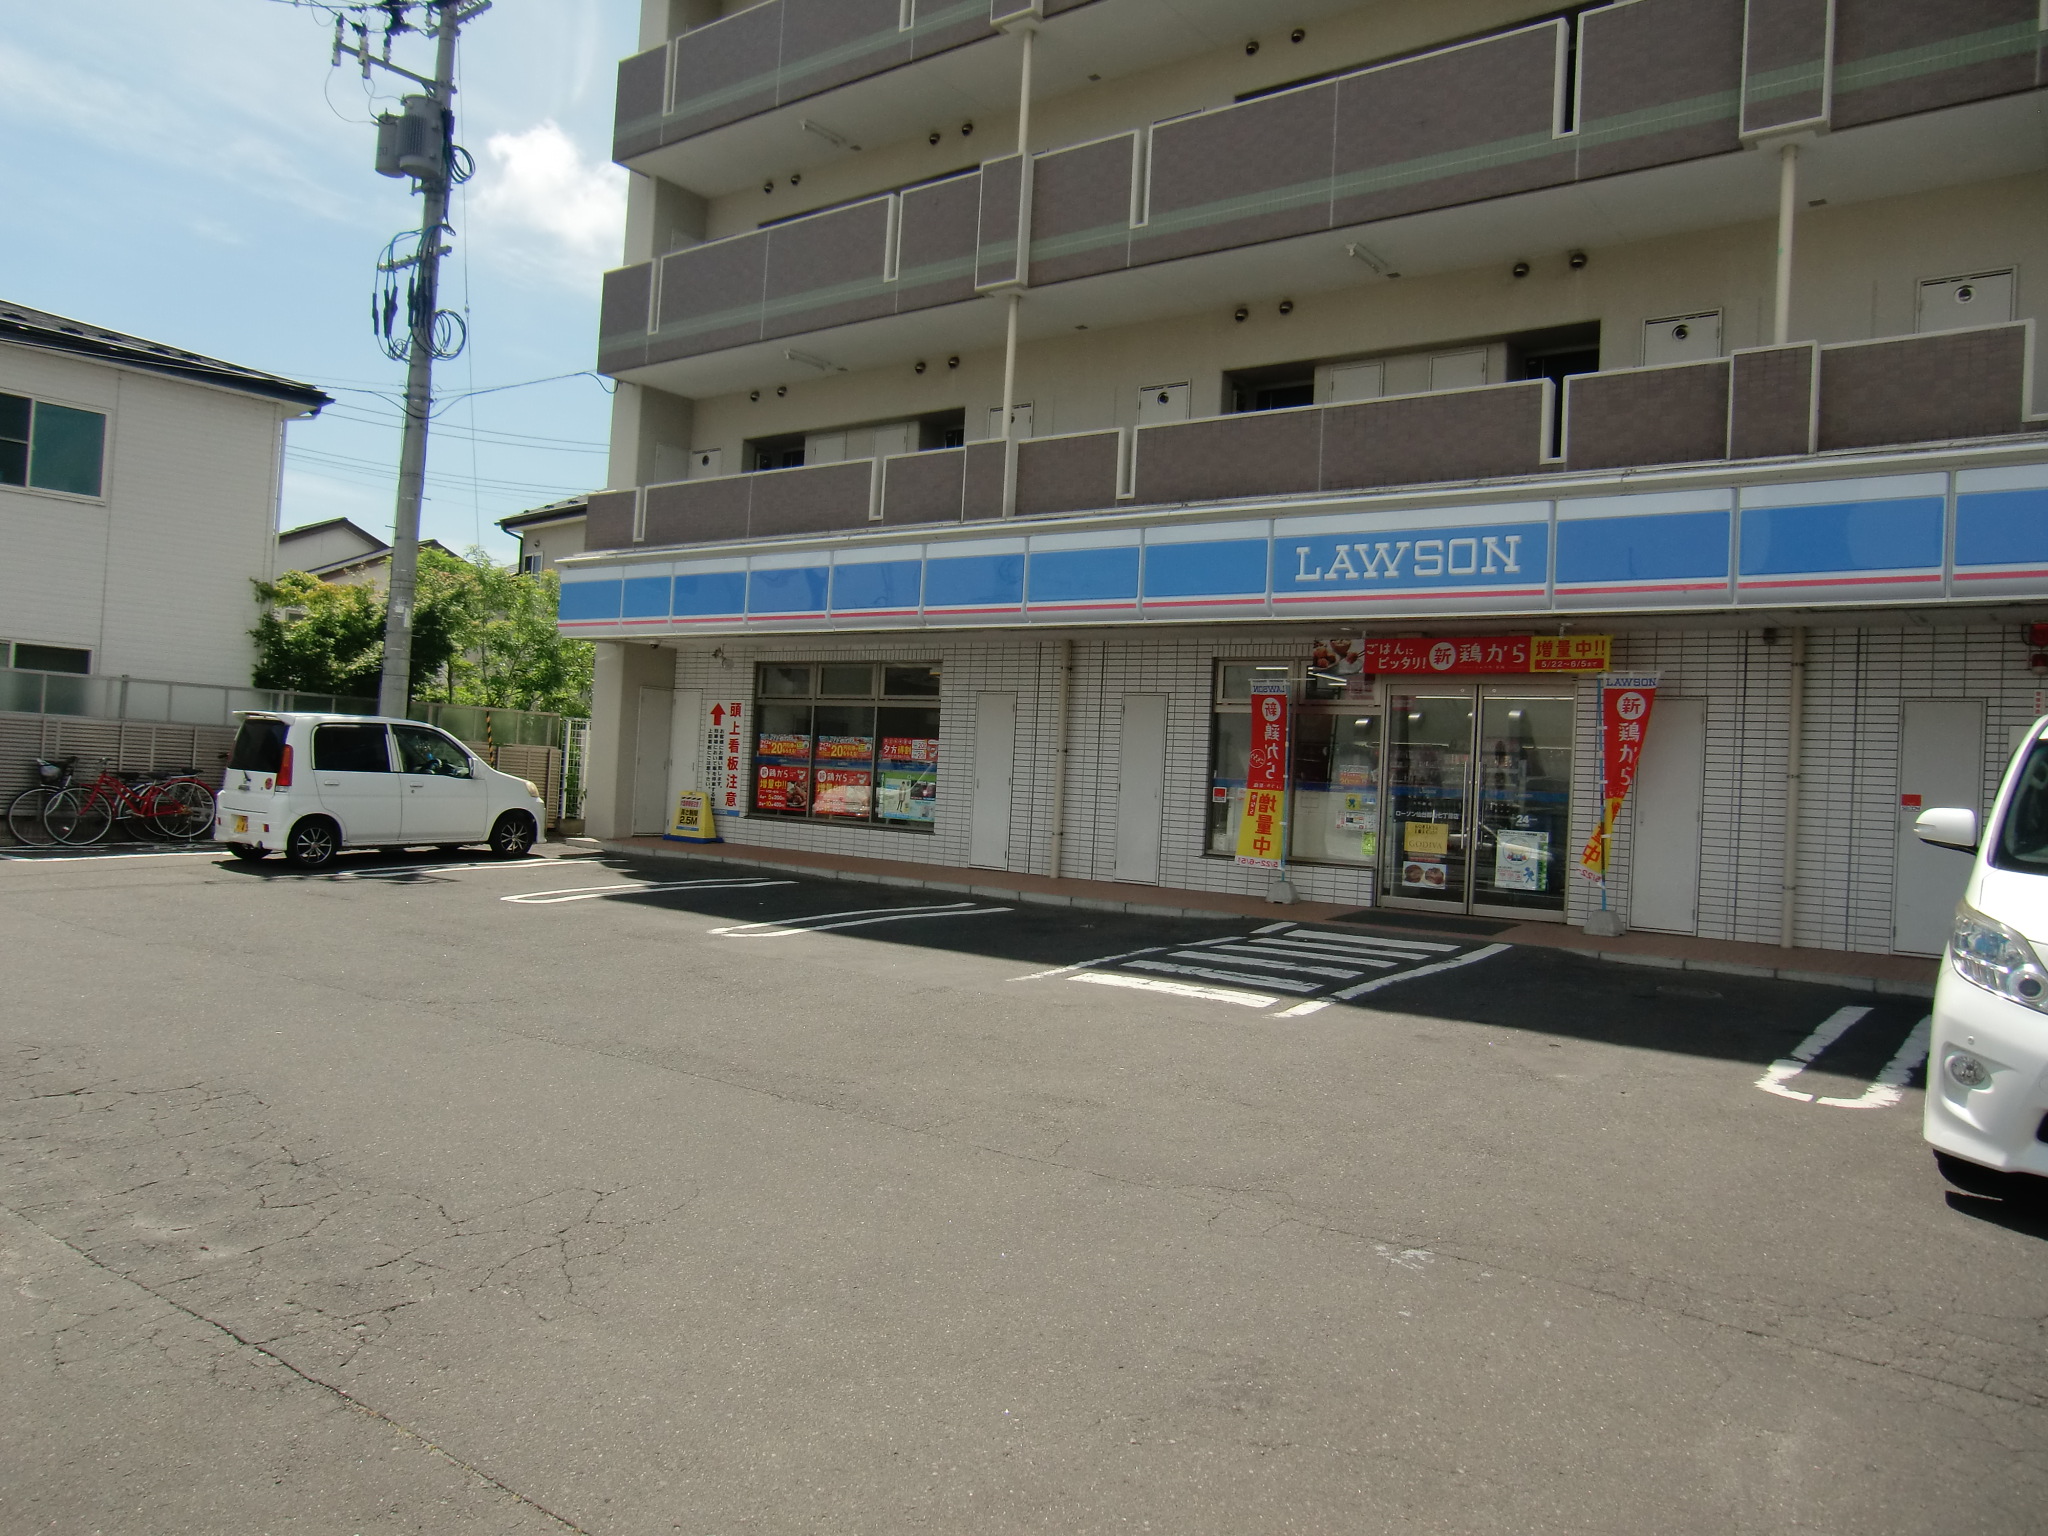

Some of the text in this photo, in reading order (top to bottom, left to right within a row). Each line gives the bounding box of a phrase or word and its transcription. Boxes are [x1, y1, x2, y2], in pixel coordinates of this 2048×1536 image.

[1295, 535, 1522, 581] LAWSON
[1366, 643, 1414, 655] ごはんに
[1378, 657, 1426, 670] ピッタリ!
[1606, 677, 1657, 687] LAWSON
[725, 702, 742, 807] 頭上看板注意
[680, 816, 698, 826] 2.5M
[1516, 814, 1530, 824] 24
[1409, 840, 1442, 849] GODIVA
